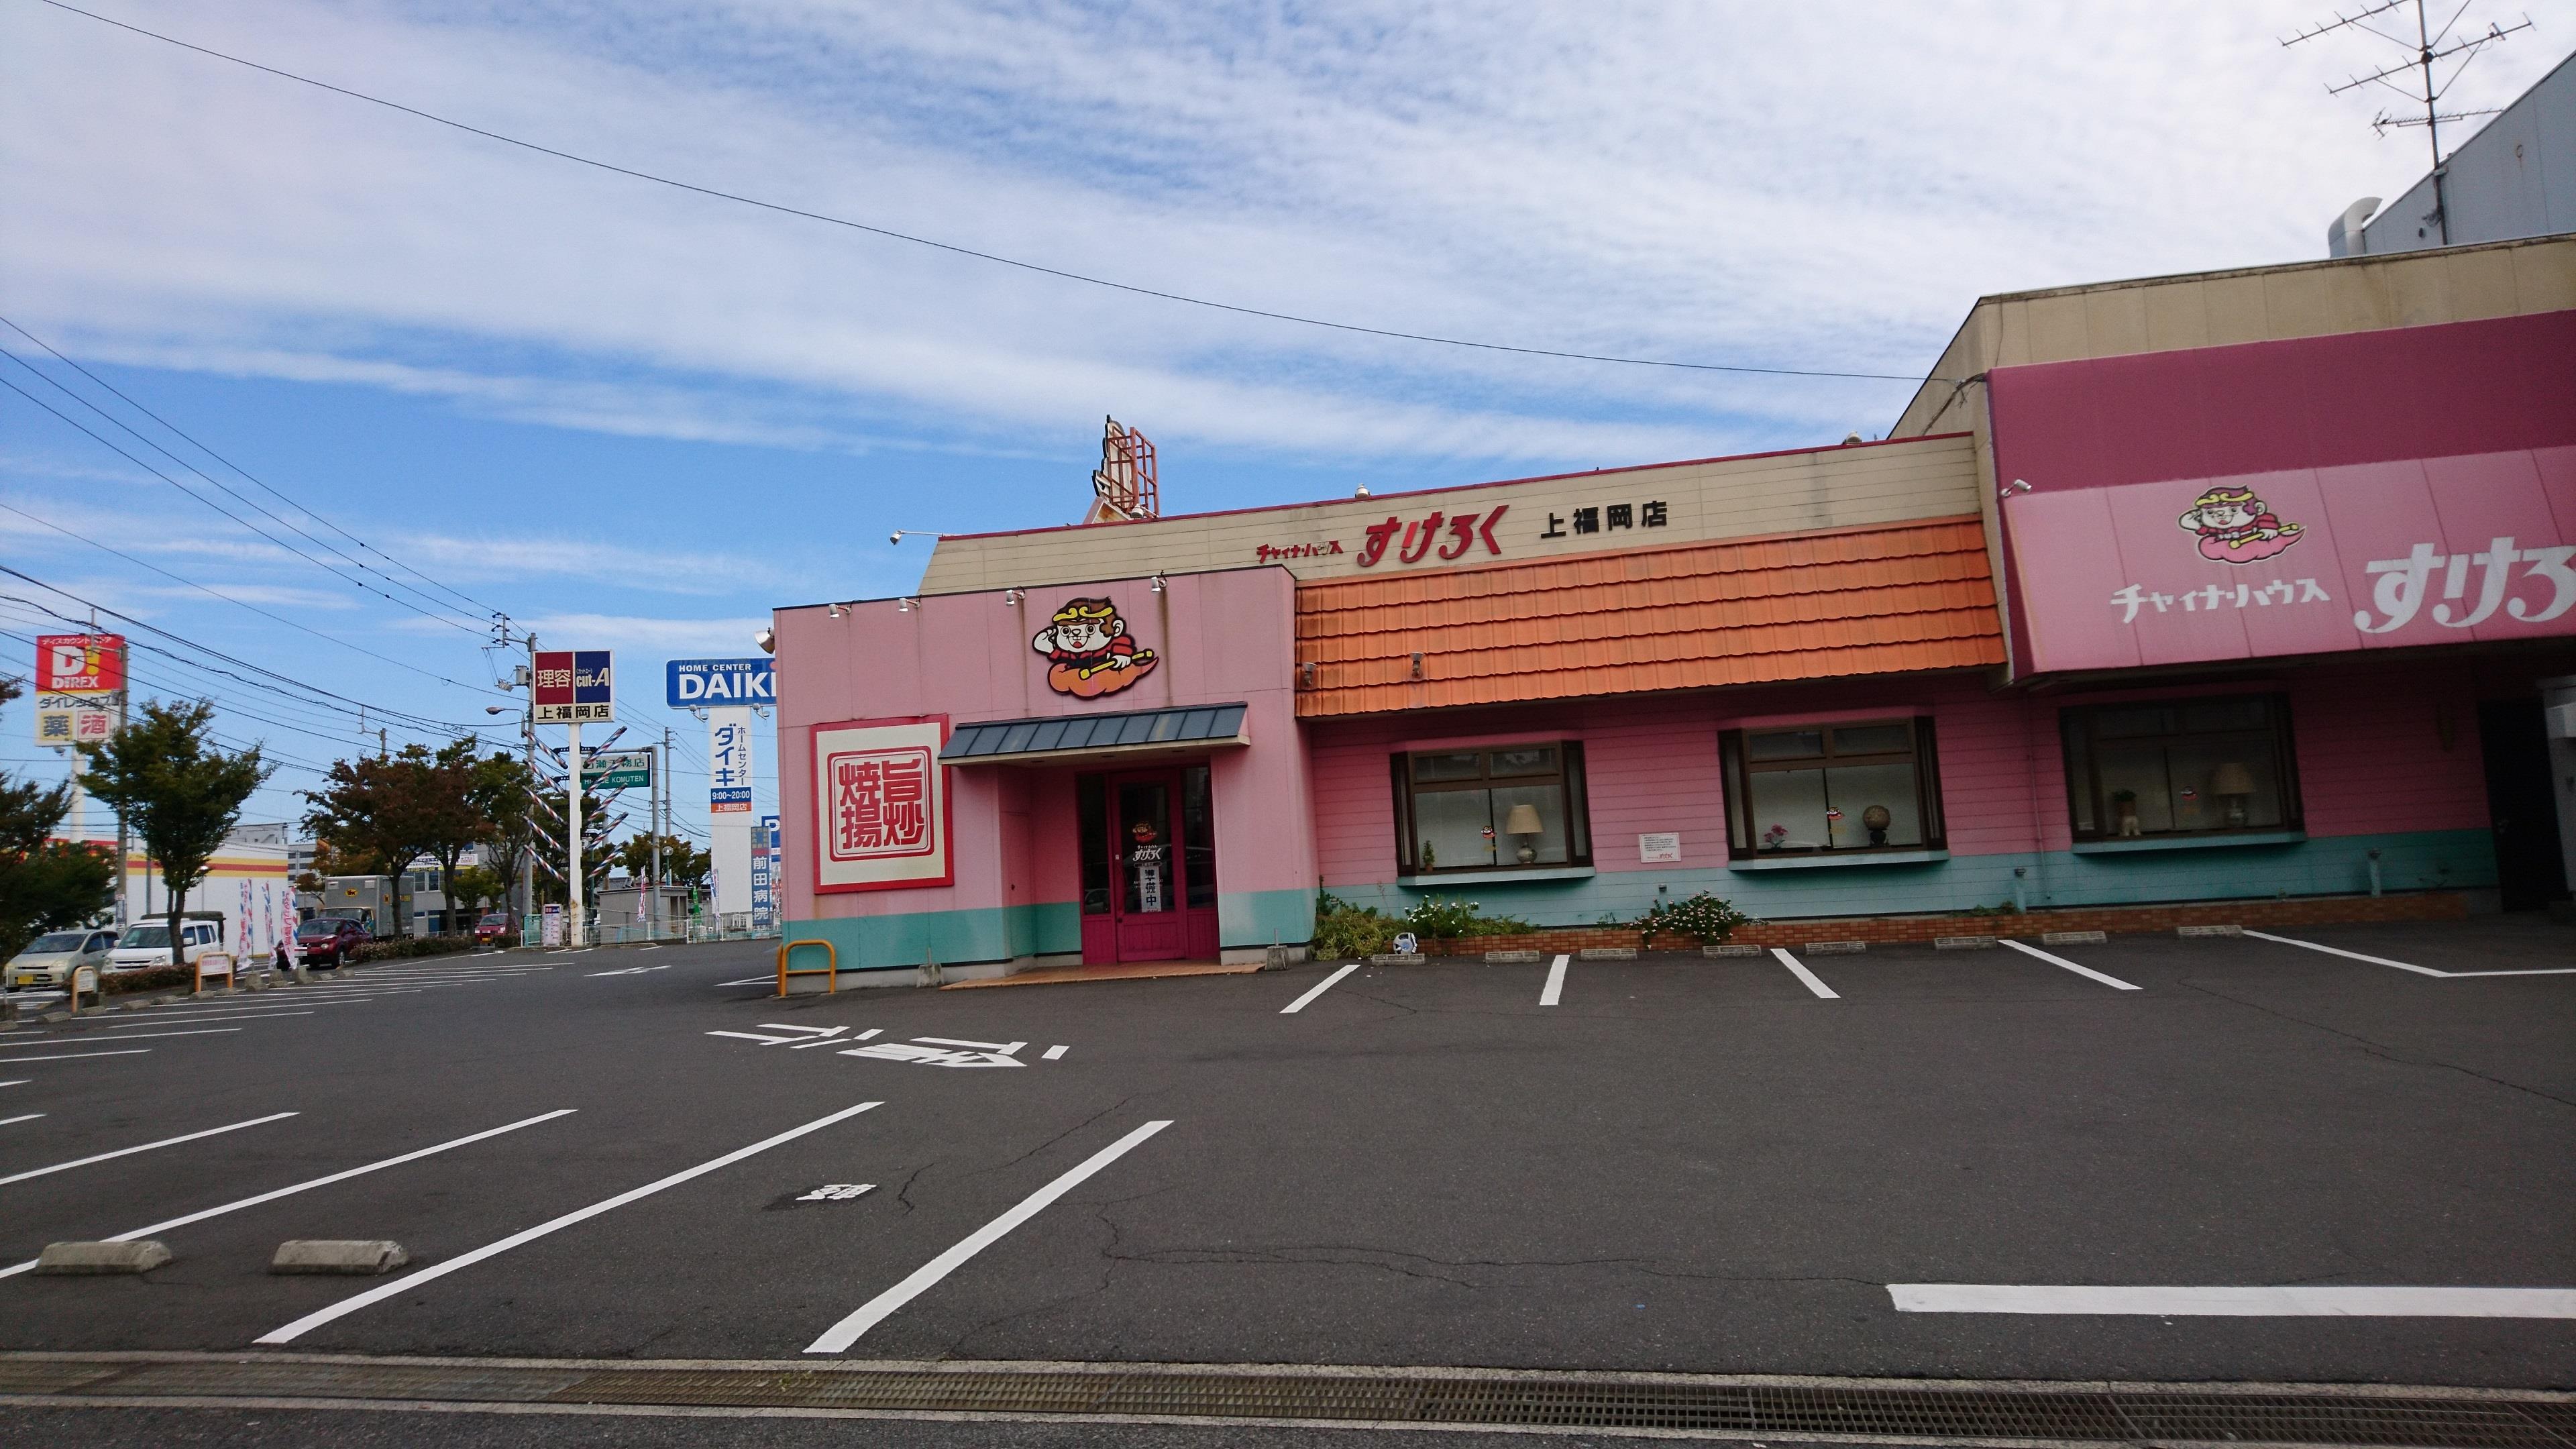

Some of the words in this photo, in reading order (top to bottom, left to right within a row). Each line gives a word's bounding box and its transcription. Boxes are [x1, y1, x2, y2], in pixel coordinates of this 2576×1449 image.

[1541, 500, 1668, 539] 上福岡店
[1356, 504, 1511, 567] すけろく
[537, 669, 571, 688] 理容
[576, 667, 610, 688] cut-A
[679, 664, 708, 672] HOME
[712, 663, 751, 672] CENTER
[537, 704, 610, 720] 上福岡店
[43, 714, 70, 737] 薬
[80, 714, 107, 736] 酒
[714, 722, 737, 787] ダイキ
[737, 727, 747, 786] ホームセンター
[611, 775, 644, 784] KOMUTEN
[715, 803, 747, 812] 上福岡店
[753, 856, 769, 921] 前田病院
